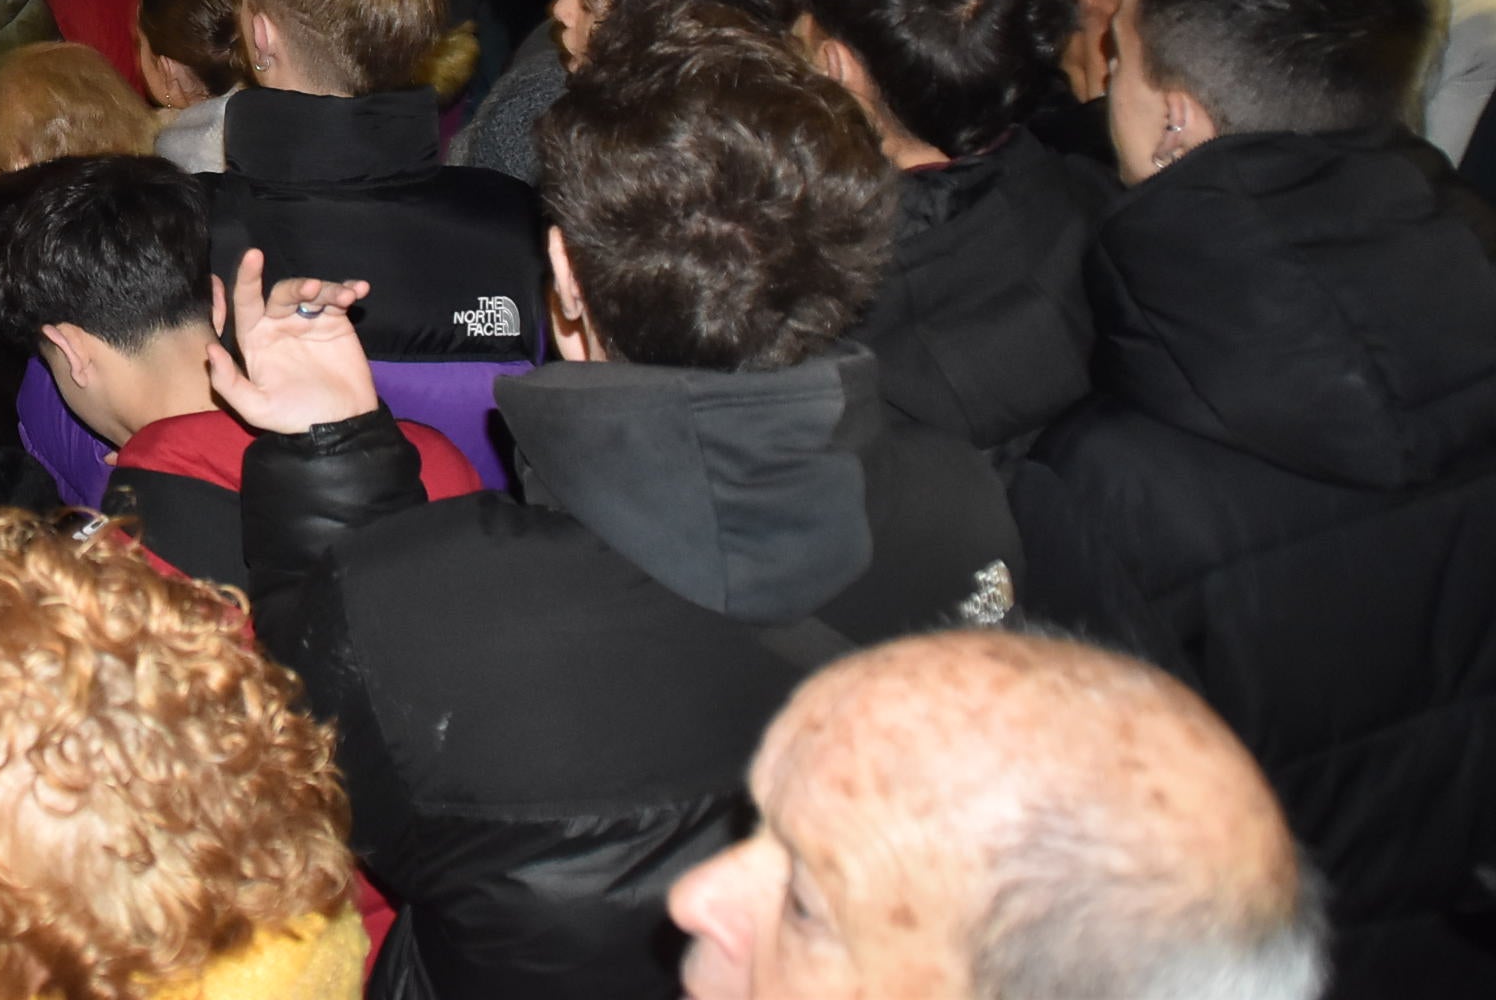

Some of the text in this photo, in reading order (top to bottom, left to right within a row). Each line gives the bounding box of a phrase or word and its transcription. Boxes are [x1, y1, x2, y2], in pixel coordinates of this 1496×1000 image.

[477, 296, 504, 310] THE
[453, 309, 502, 324] NORTH
[467, 322, 505, 337] FACE
